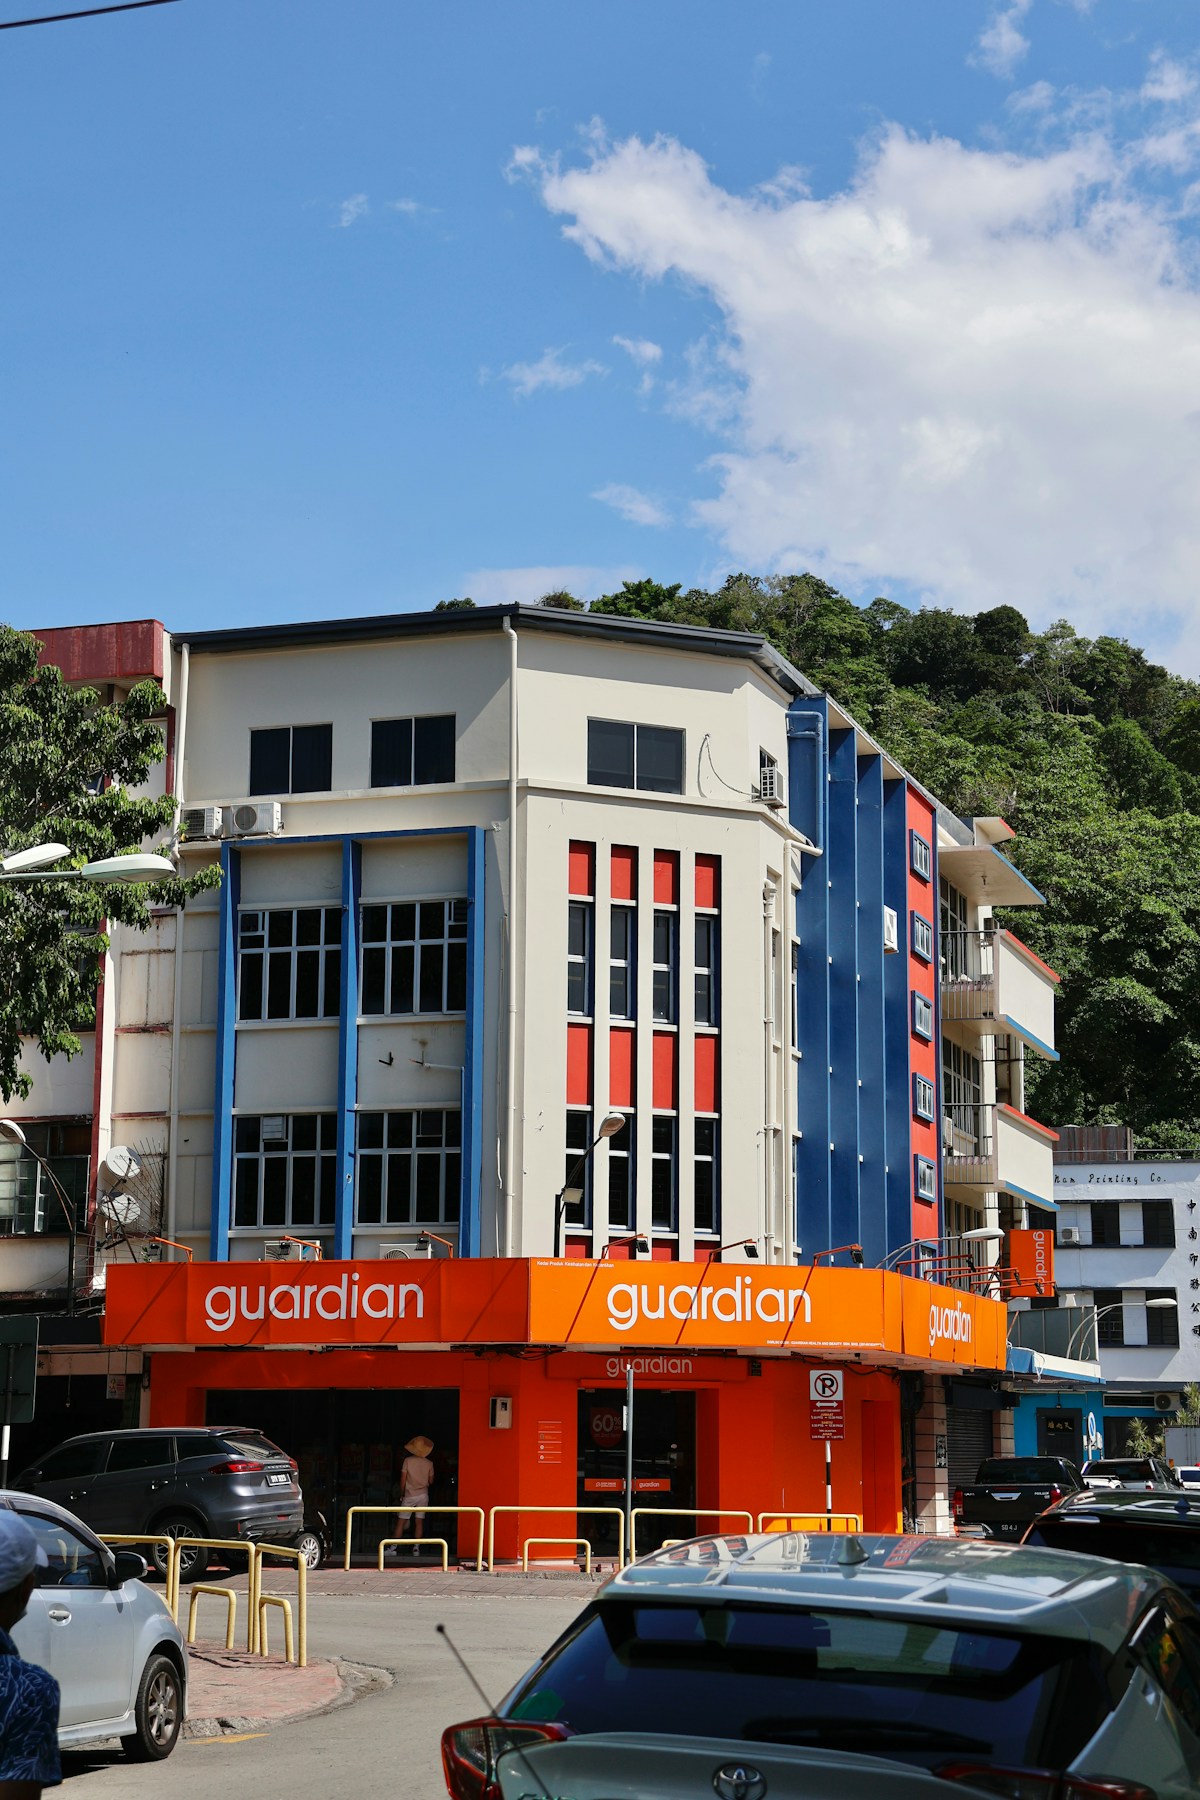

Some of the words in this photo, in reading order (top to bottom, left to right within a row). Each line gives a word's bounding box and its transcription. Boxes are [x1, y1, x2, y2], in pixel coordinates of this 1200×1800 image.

[1088, 1173, 1138, 1185] Printing
[1150, 1172, 1167, 1182] Co.
[205, 1272, 424, 1332] guardian
[607, 1276, 811, 1331] guardian
[929, 1300, 972, 1347] guardian
[606, 1356, 693, 1378] guardian
